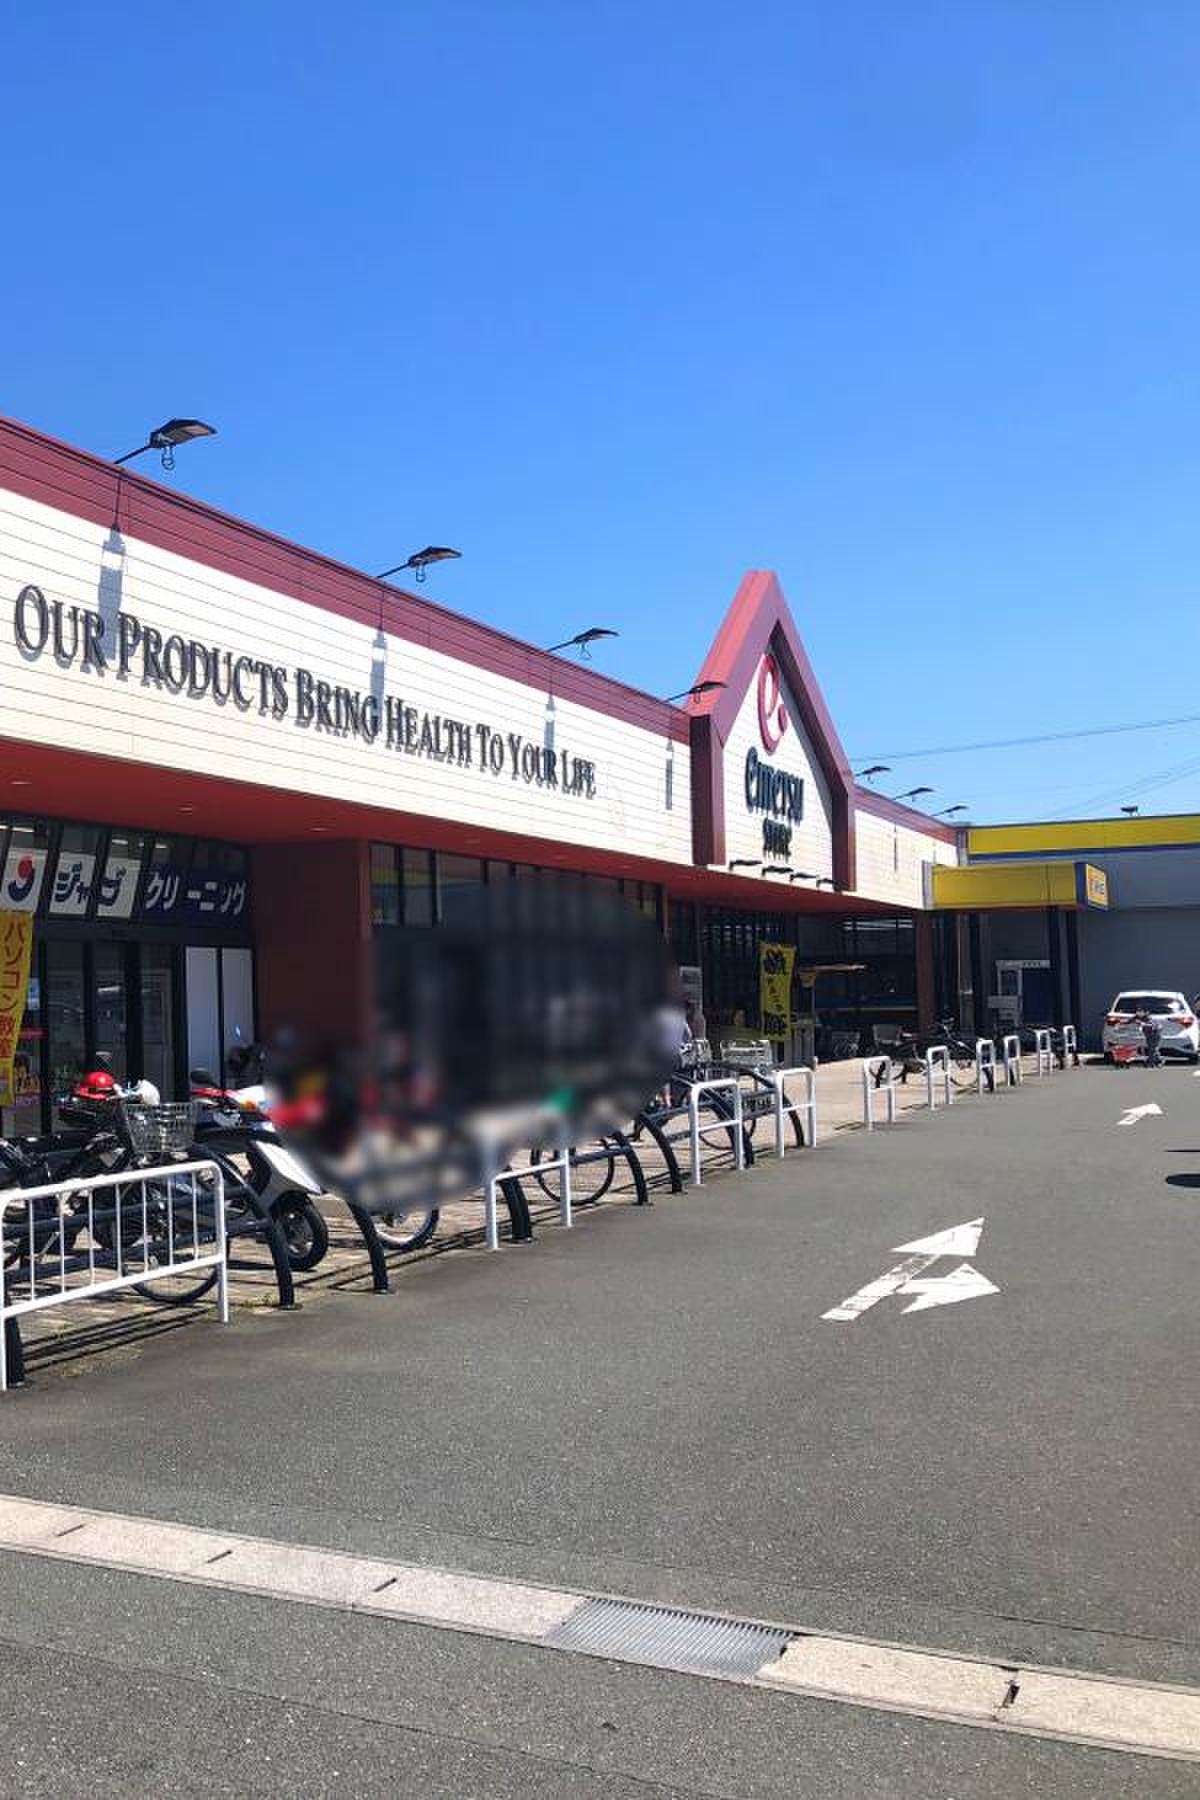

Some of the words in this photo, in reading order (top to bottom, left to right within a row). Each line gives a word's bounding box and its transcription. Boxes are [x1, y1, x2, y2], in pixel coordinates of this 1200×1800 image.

[14, 584, 108, 669] OUR
[118, 612, 289, 715] PRODUCTS
[294, 668, 381, 739] BRING
[384, 697, 471, 764] HEALTH
[476, 723, 504, 770] TO
[508, 735, 558, 785] YOUR
[561, 748, 597, 796] LIFE
